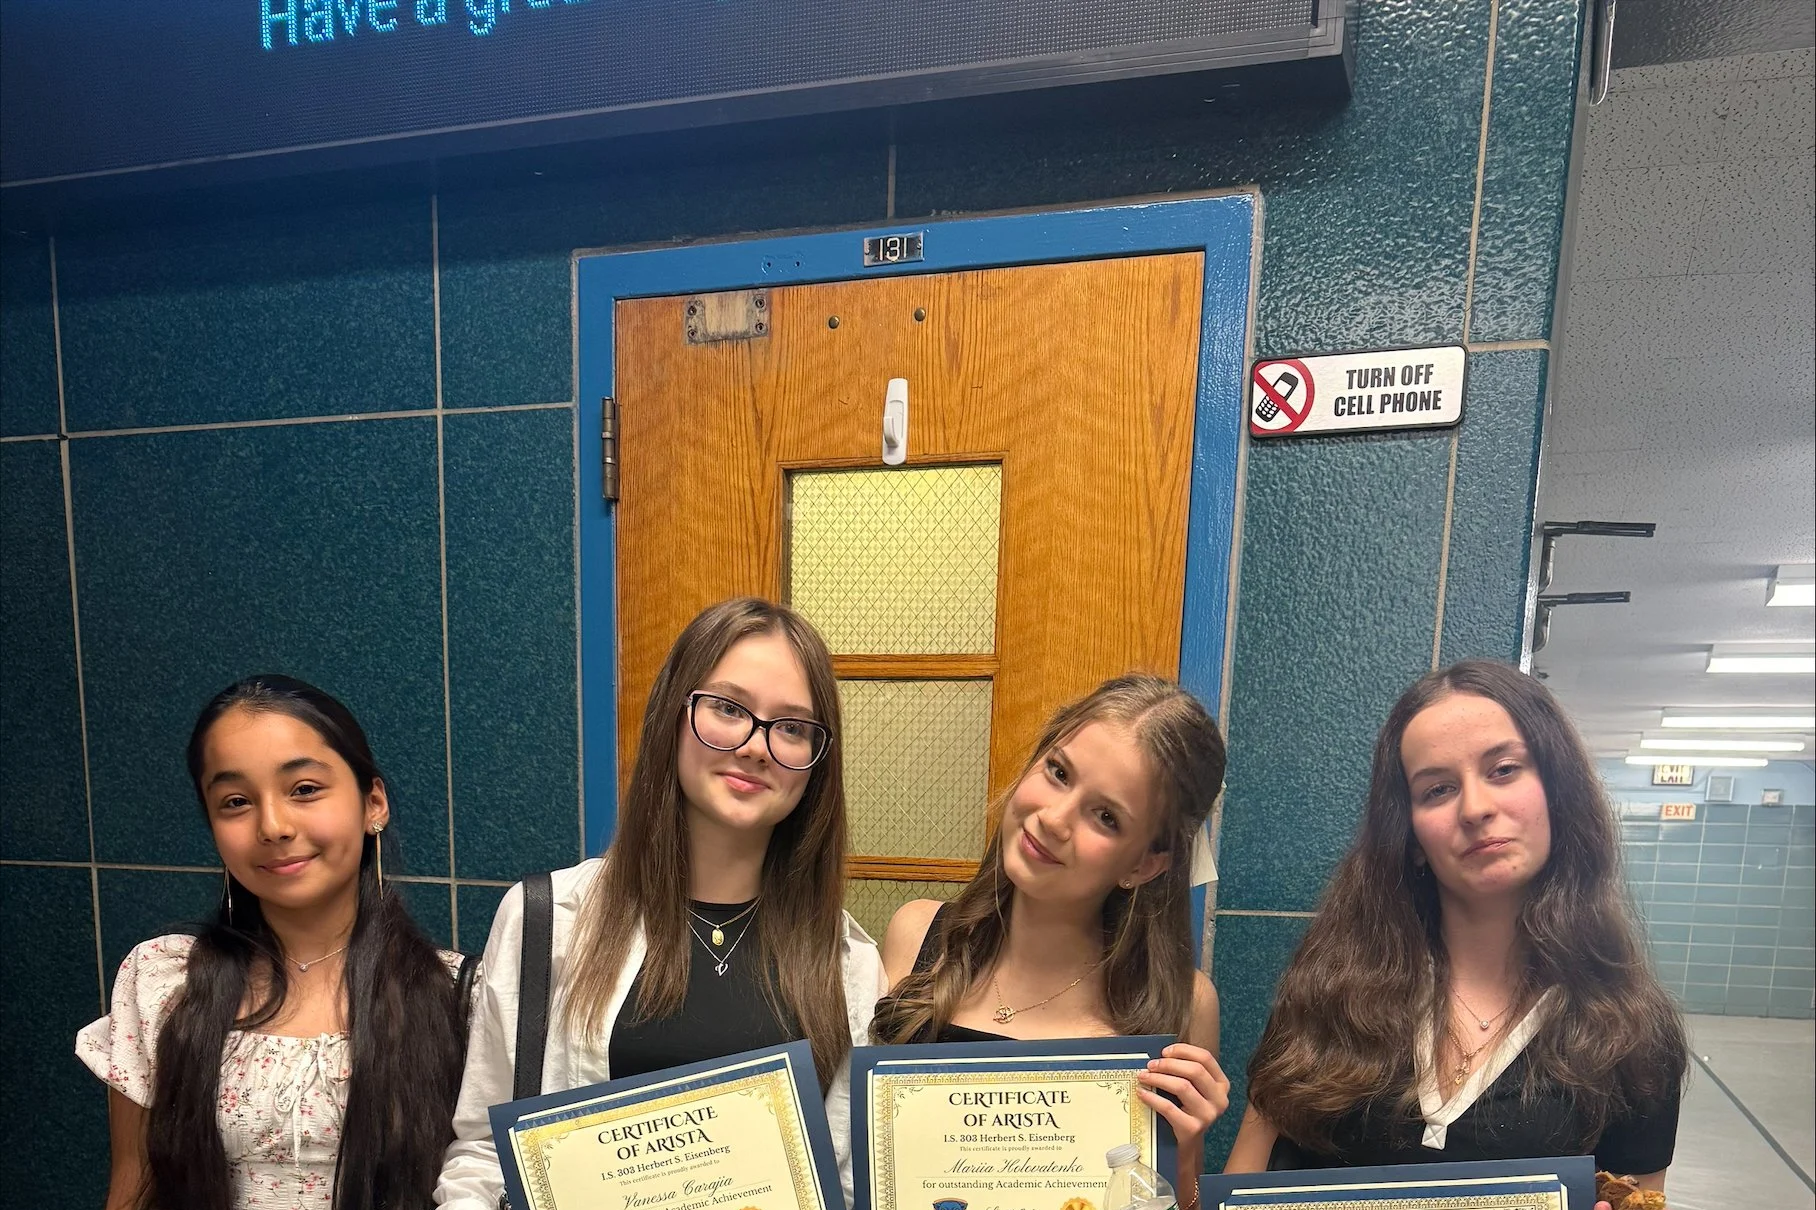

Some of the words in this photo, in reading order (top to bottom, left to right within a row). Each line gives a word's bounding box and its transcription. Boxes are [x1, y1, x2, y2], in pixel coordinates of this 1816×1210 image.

[260, 0, 398, 49] Have
[880, 237, 907, 261] 131
[1346, 367, 1396, 390] TURN
[1401, 363, 1434, 386] OFF
[1334, 396, 1375, 417] CELL
[1379, 390, 1442, 414] PHONE
[1665, 805, 1693, 817] EXIT
[948, 1090, 1071, 1108] CERTIFICATE
[598, 1106, 718, 1144] CERTIFICATE
[963, 1113, 988, 1127] OF
[992, 1112, 1061, 1129] ARISTA
[617, 1144, 641, 1160] OF
[645, 1128, 714, 1155] ARISTA
[944, 1135, 958, 1143] I.S.
[960, 1135, 978, 1143] 303
[980, 1133, 1016, 1143] Herbert
[1018, 1134, 1027, 1142] S.
[1029, 1133, 1076, 1143] Eisenberg
[601, 1172, 616, 1181] I.S.
[618, 1166, 635, 1177] 303
[637, 1158, 673, 1172] Herbert
[674, 1155, 683, 1164] S.
[684, 1145, 731, 1161] Eisenberg
[632, 1173, 661, 1184] certificate
[667, 1166, 689, 1176] proudly
[690, 1161, 713, 1171] awarded
[944, 1159, 995, 1174] Mariia
[997, 1156, 1084, 1174] Holovatenko
[712, 1184, 773, 1206] Achievement
[922, 1180, 937, 1189] for
[938, 1180, 994, 1190] outstanding
[995, 1180, 1042, 1189] Academic
[1044, 1179, 1108, 1189] Achievement
[622, 1191, 677, 1210] Vanessa
